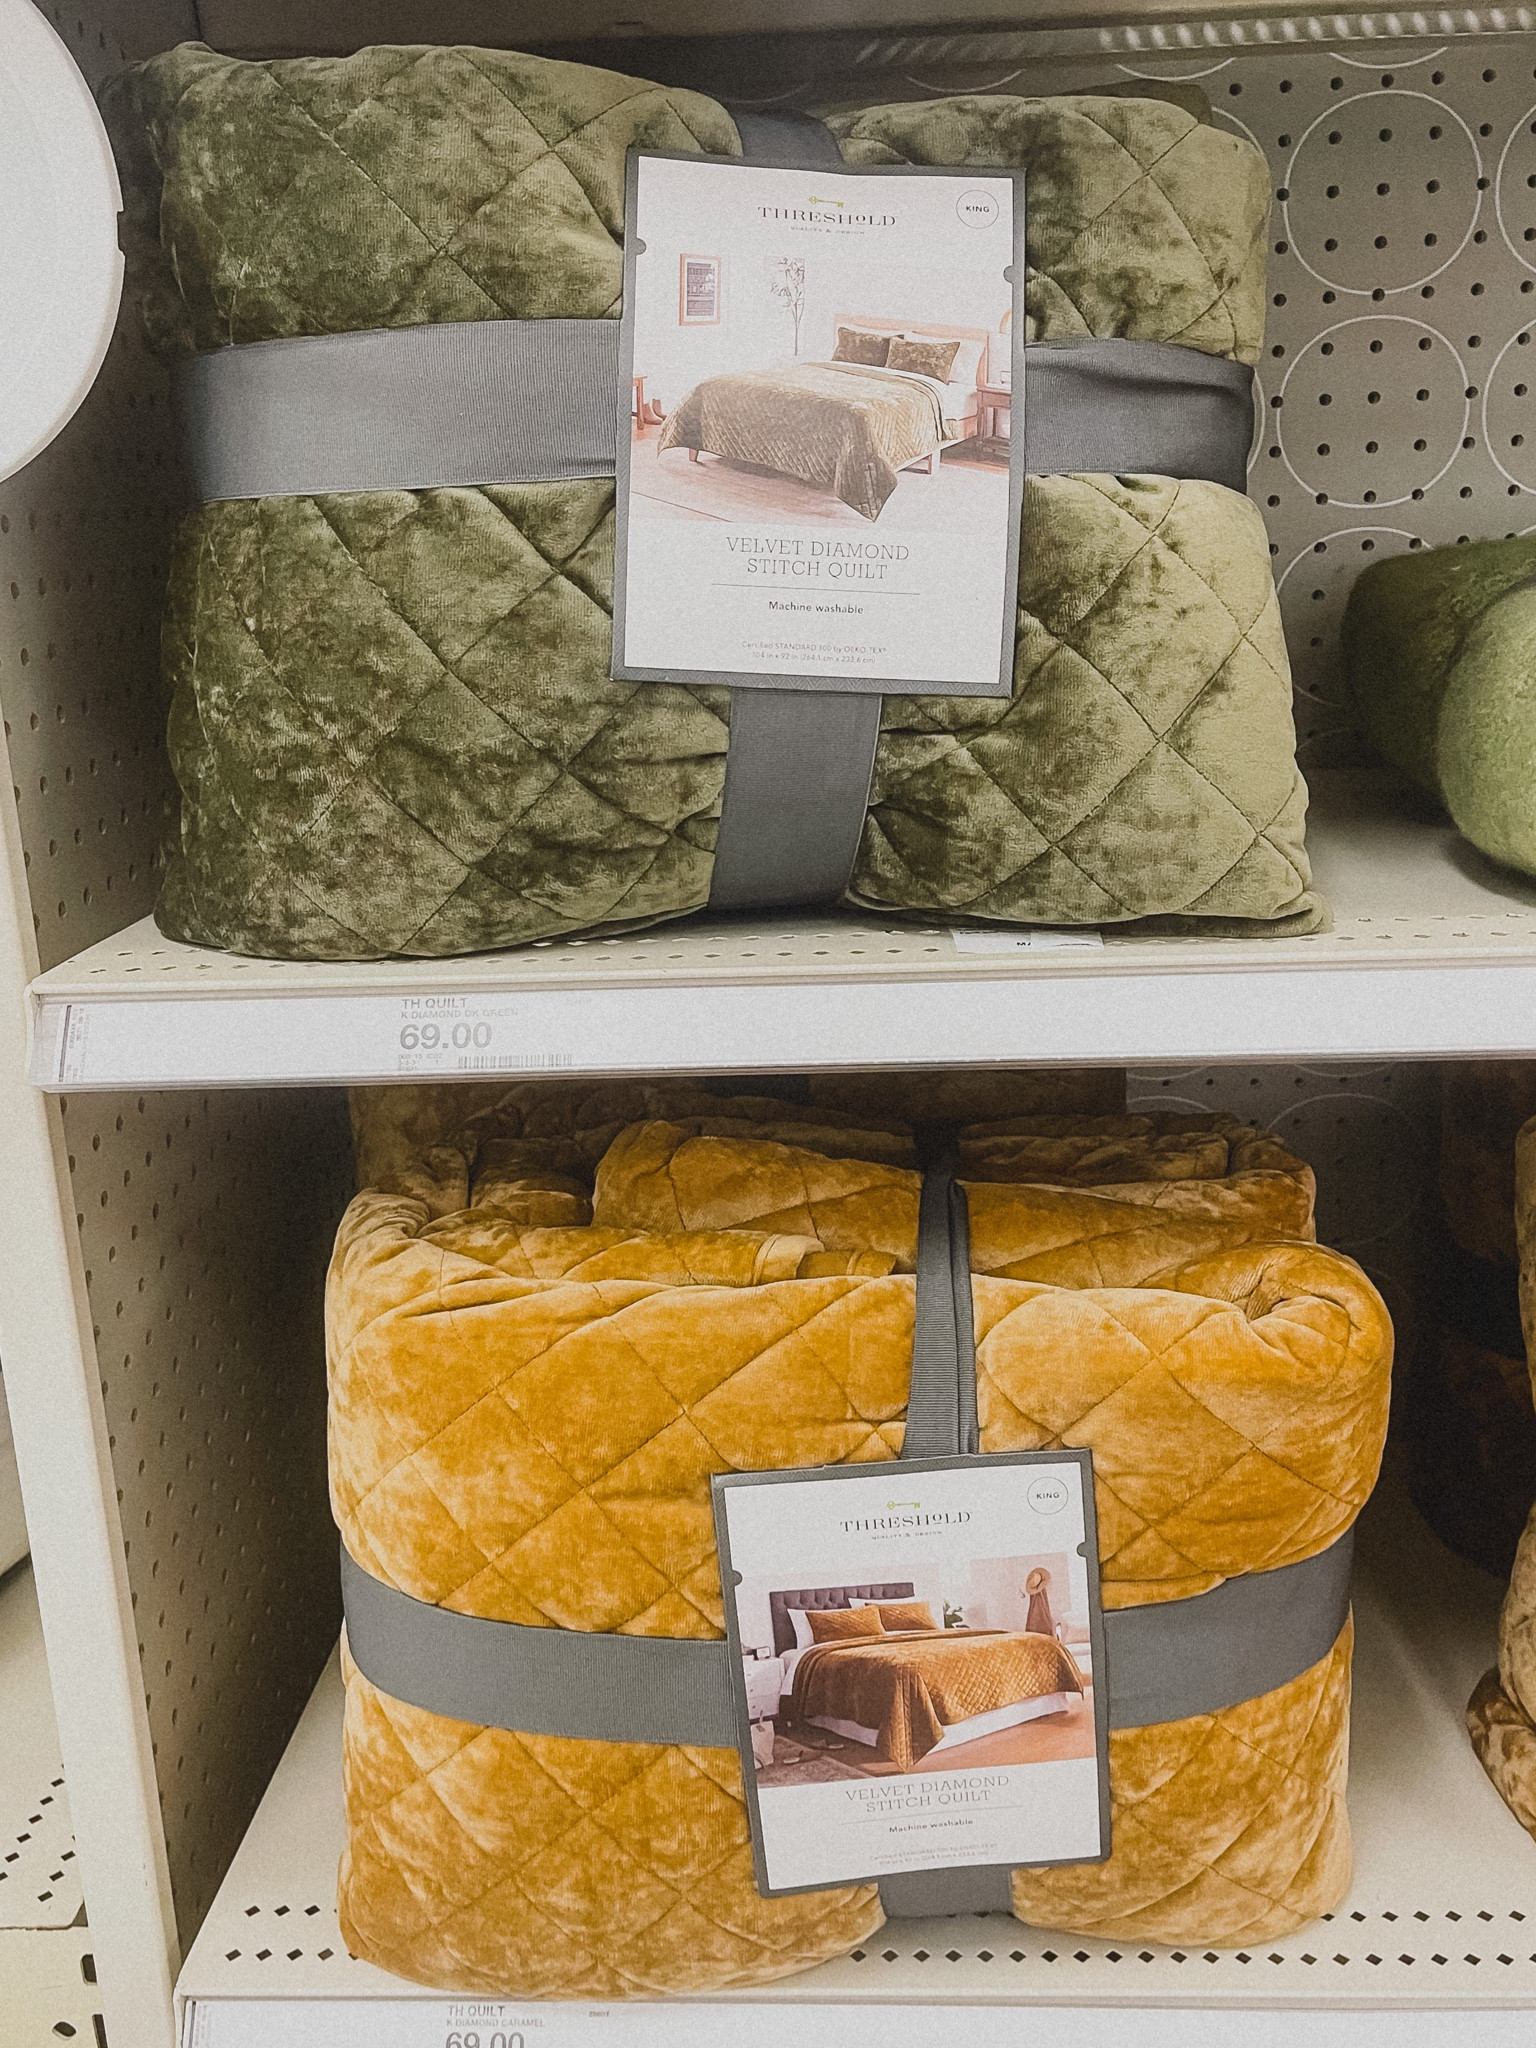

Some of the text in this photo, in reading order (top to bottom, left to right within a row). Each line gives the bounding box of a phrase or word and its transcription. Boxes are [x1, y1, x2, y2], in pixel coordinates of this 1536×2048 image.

[965, 204, 990, 213] KING
[726, 536, 910, 561] VELVET DIAMOND
[747, 558, 888, 580] STITCH QUILT
[768, 601, 864, 615] Machine washable
[401, 997, 469, 1009] TH QUILT
[401, 1011, 408, 1019] K
[411, 1009, 461, 1019] DIAMOND
[400, 1022, 492, 1050] 69.00
[1036, 1492, 1060, 1500] KING
[846, 1775, 1010, 1801] VELVET DIAMOND
[866, 1789, 992, 1813] STITCH QUILT
[889, 1818, 974, 1833] Machine washable
[449, 2005, 505, 2017] TH QUILT
[447, 2018, 545, 2028] K DIAMOND CARAMEL
[445, 2032, 525, 2048] 6900
